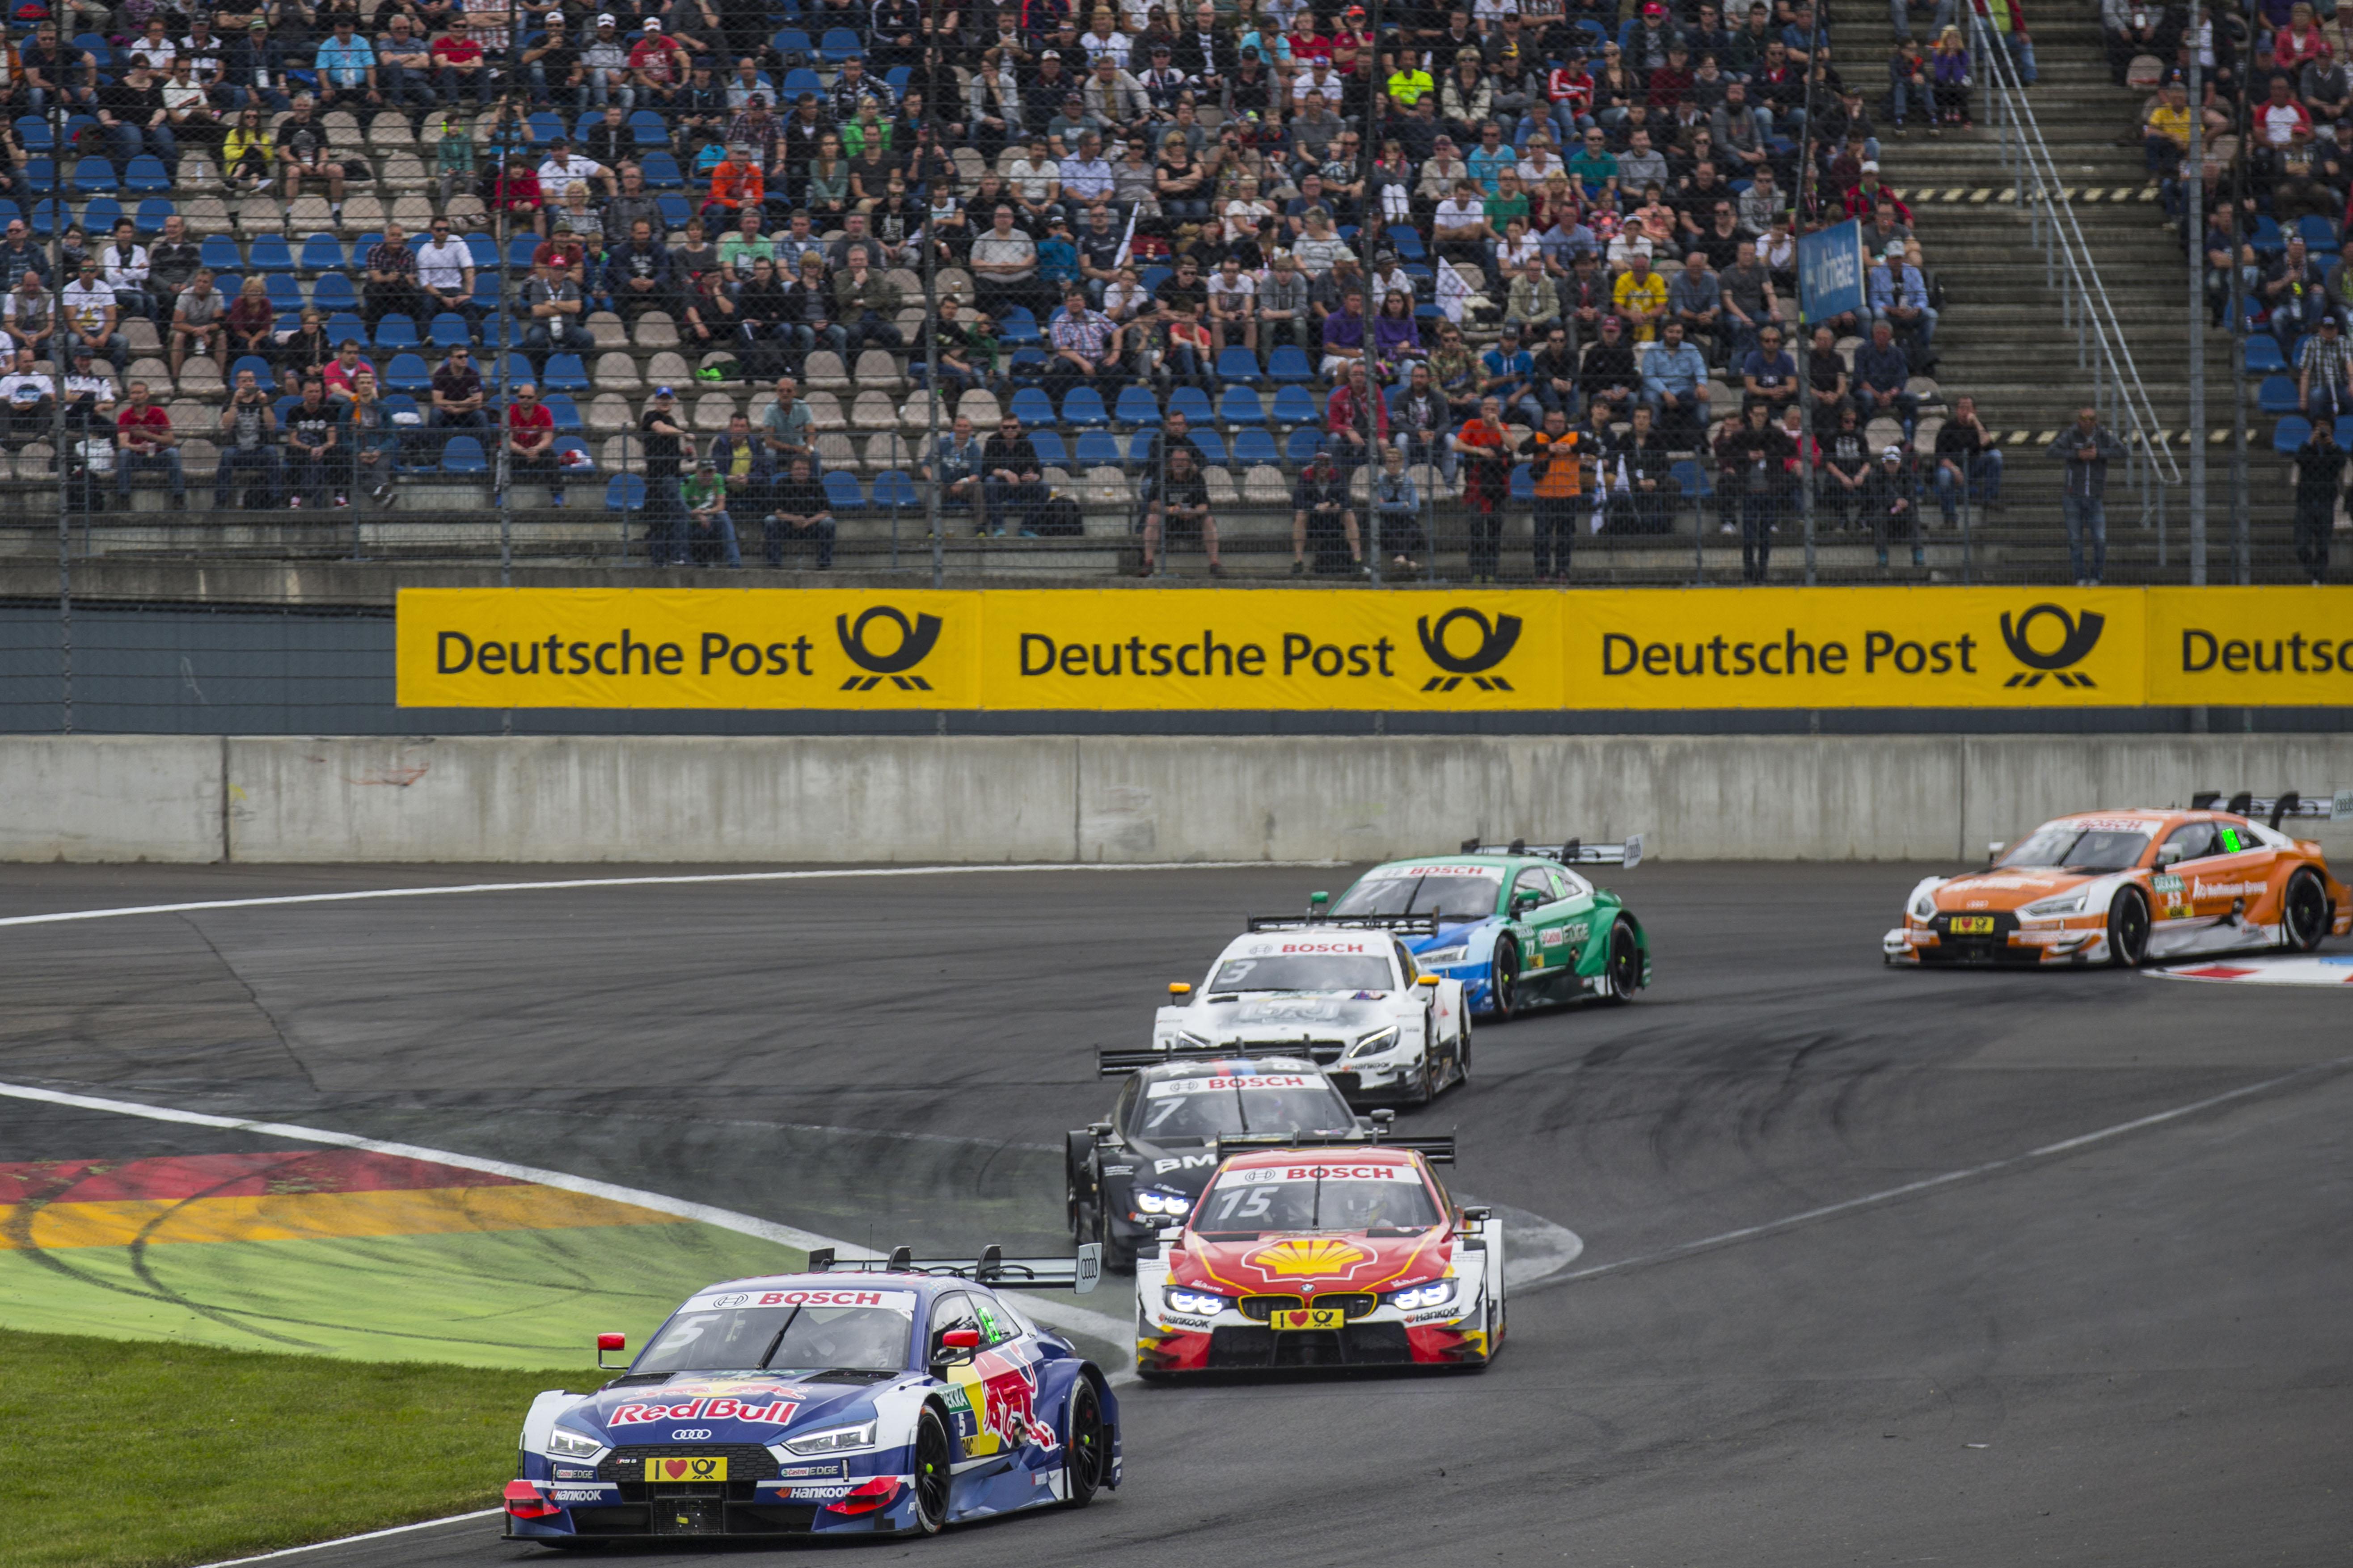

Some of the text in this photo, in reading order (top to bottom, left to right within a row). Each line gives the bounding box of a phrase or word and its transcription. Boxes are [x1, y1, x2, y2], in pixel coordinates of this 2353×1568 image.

[437, 628, 813, 676] Deutsche Post
[1020, 630, 1394, 678] Deutsche Post
[1603, 628, 1977, 676] Deutsche Post
[2076, 820, 2144, 830] BOSCH
[1410, 867, 1483, 875] BOSCH
[2207, 879, 2268, 898] Hoffmann Group
[1563, 923, 1589, 944] EDGE
[1281, 944, 1364, 953] BOSCH
[1219, 960, 1257, 983] 3
[1208, 1076, 1304, 1089] BOSCH
[1147, 1097, 1186, 1129] 7
[1154, 1153, 1218, 1175] BM
[1287, 1167, 1394, 1180] BOSCH
[1217, 1186, 1280, 1220] 15
[758, 1292, 882, 1305] BOSCH
[656, 1315, 721, 1350] 5
[609, 1399, 798, 1426] Red Bull
[957, 1412, 966, 1437] 5
[573, 1470, 594, 1479] EDGE
[788, 1465, 839, 1476] Castrol EDGE
